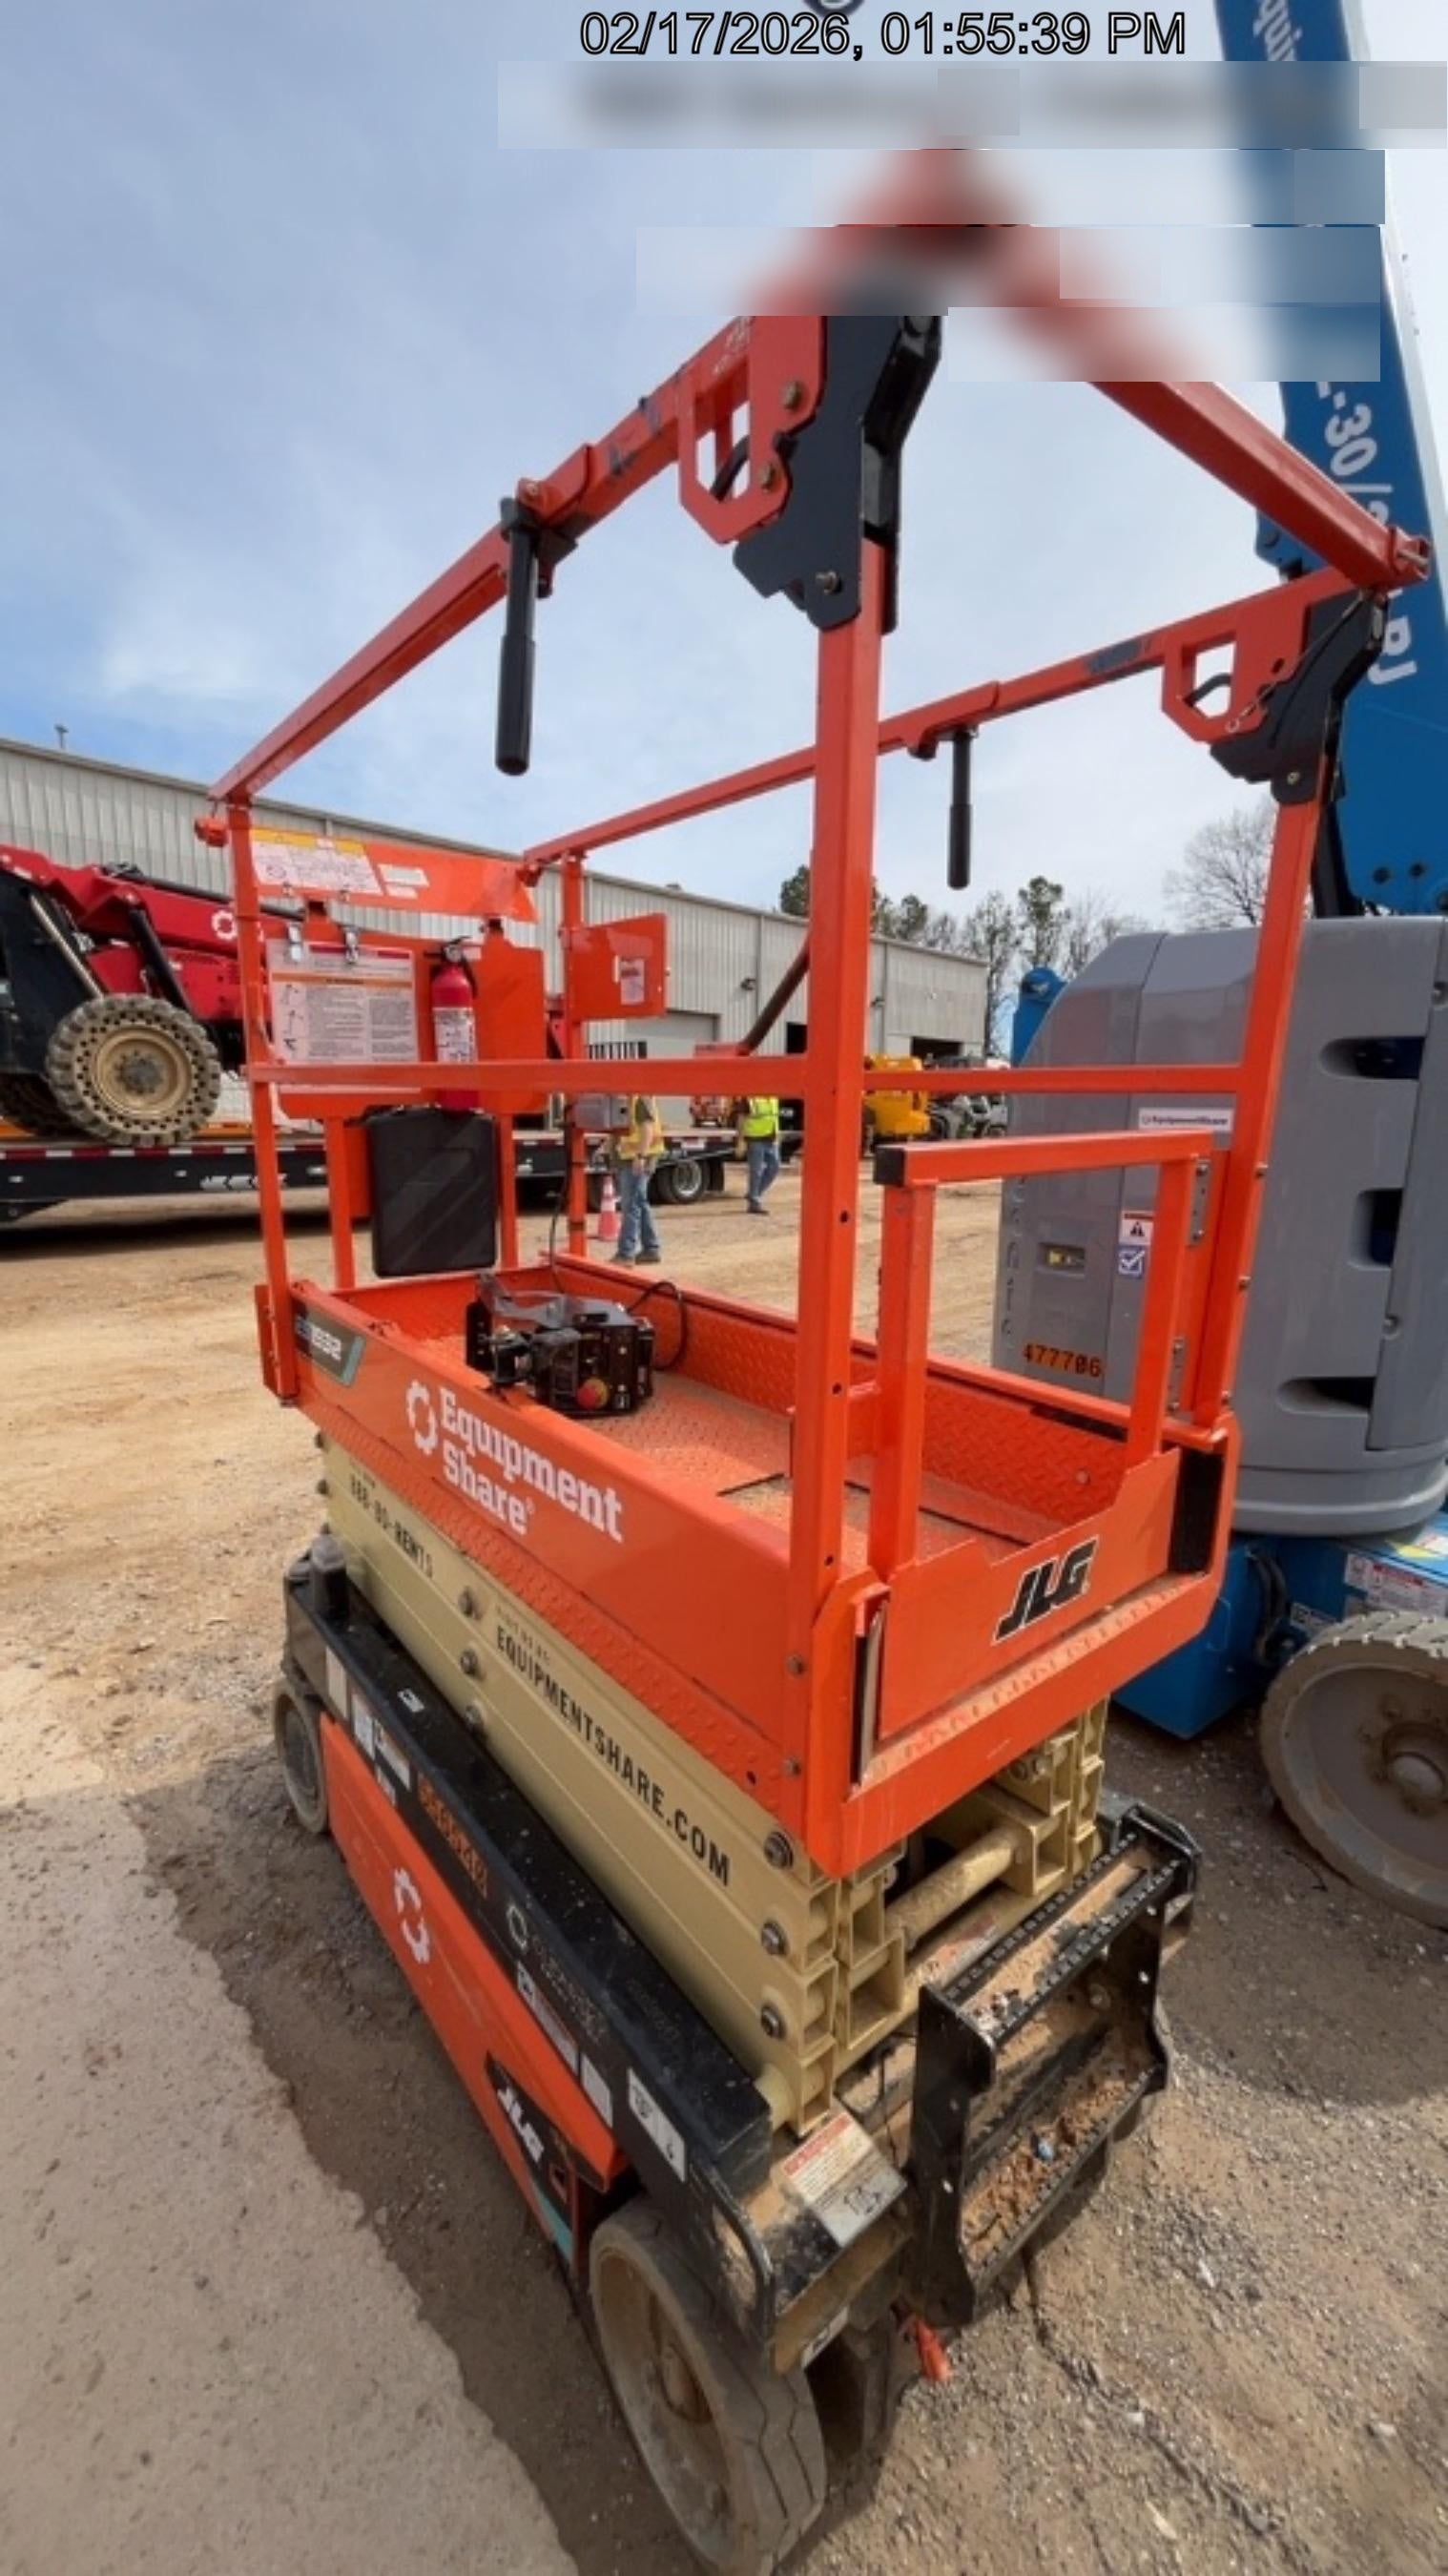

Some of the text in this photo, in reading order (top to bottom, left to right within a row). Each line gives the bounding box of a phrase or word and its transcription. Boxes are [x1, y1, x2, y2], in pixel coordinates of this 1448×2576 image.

[440, 1386, 624, 1544] Equipment
[993, 1535, 1098, 1643] JLG
[497, 1625, 730, 1886] EQUIPMENTSHARE.COM
